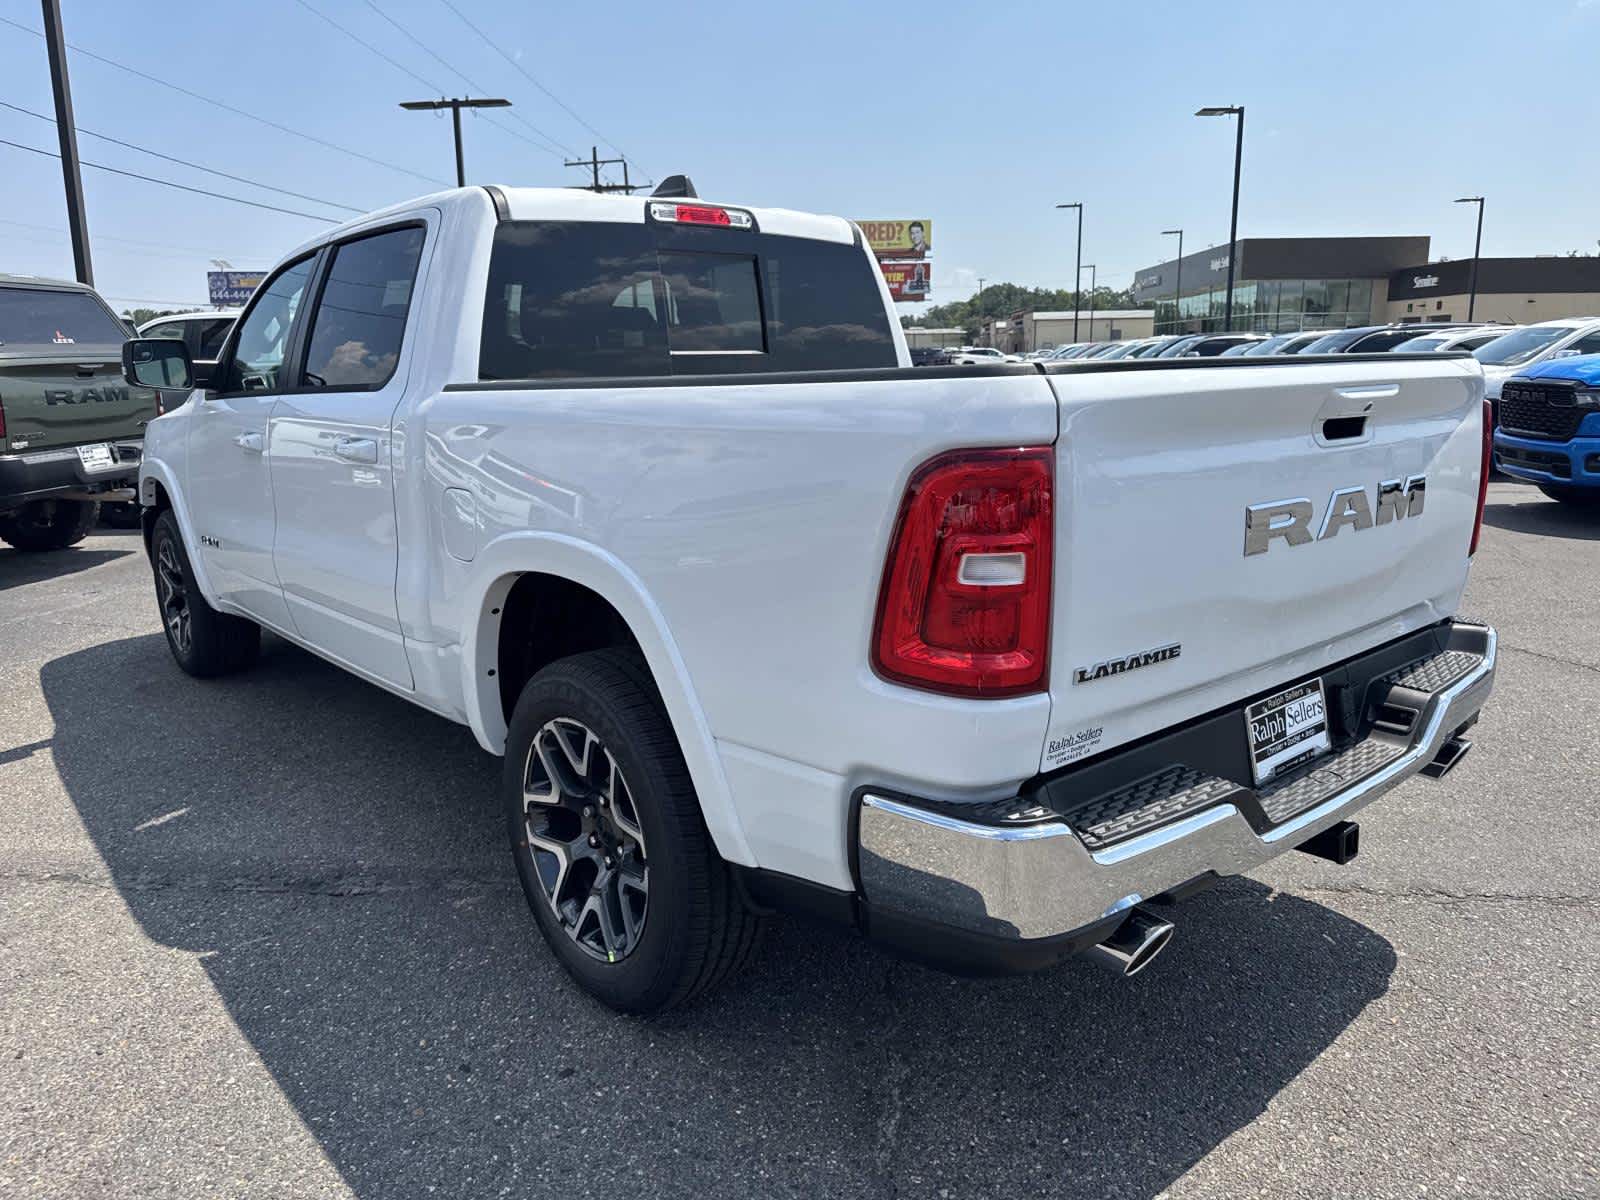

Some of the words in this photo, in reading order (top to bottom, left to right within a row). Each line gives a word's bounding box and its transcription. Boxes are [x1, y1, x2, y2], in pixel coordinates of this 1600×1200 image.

[44, 387, 129, 405] RAM
[1511, 390, 1546, 401] RAM
[1244, 473, 1426, 559] RAM
[1072, 641, 1182, 685] LARAMIE
[1250, 713, 1286, 745] Ralph
[1286, 699, 1324, 728] Sellers
[1049, 734, 1075, 752] Ralph
[1076, 727, 1104, 741] Sellers
